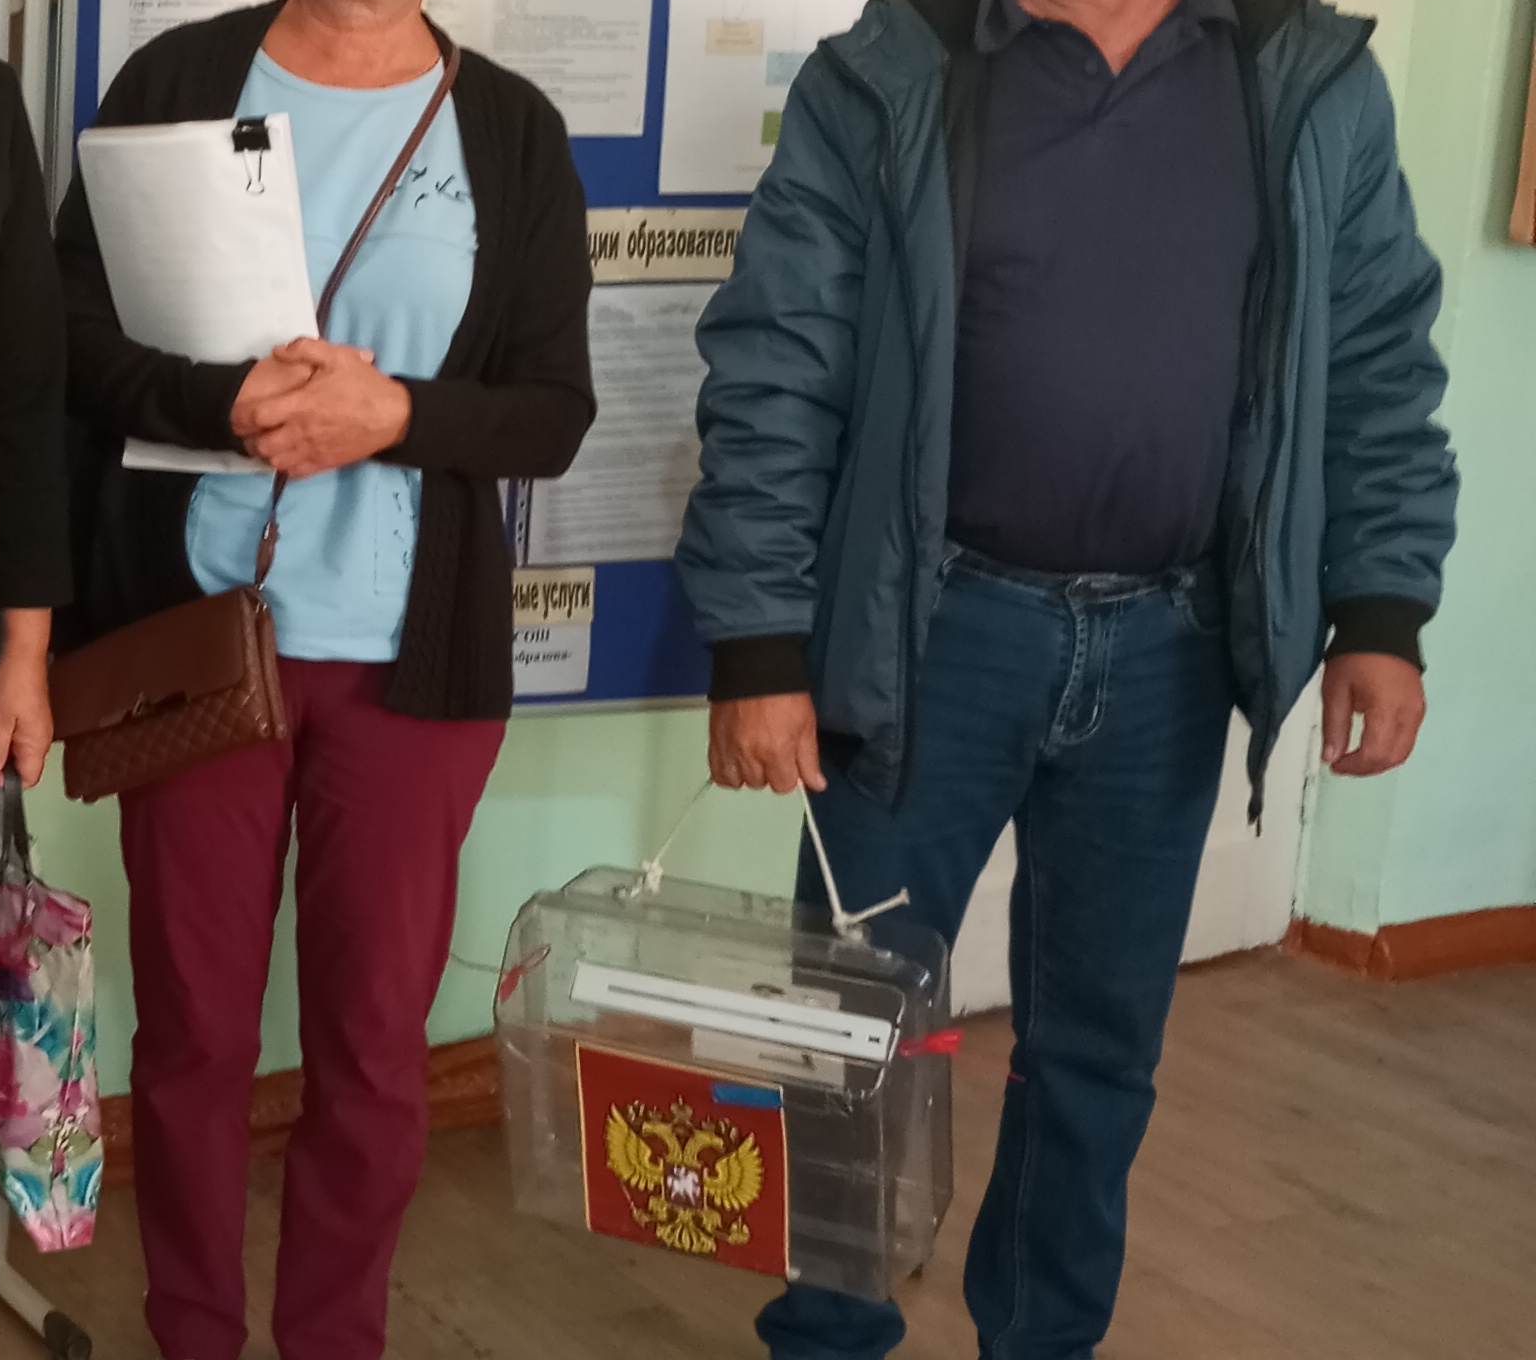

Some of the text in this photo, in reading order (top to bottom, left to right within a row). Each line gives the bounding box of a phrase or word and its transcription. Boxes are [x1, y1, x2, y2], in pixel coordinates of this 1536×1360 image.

[589, 219, 741, 268] ции образовател
[512, 581, 591, 620] ные услуги
